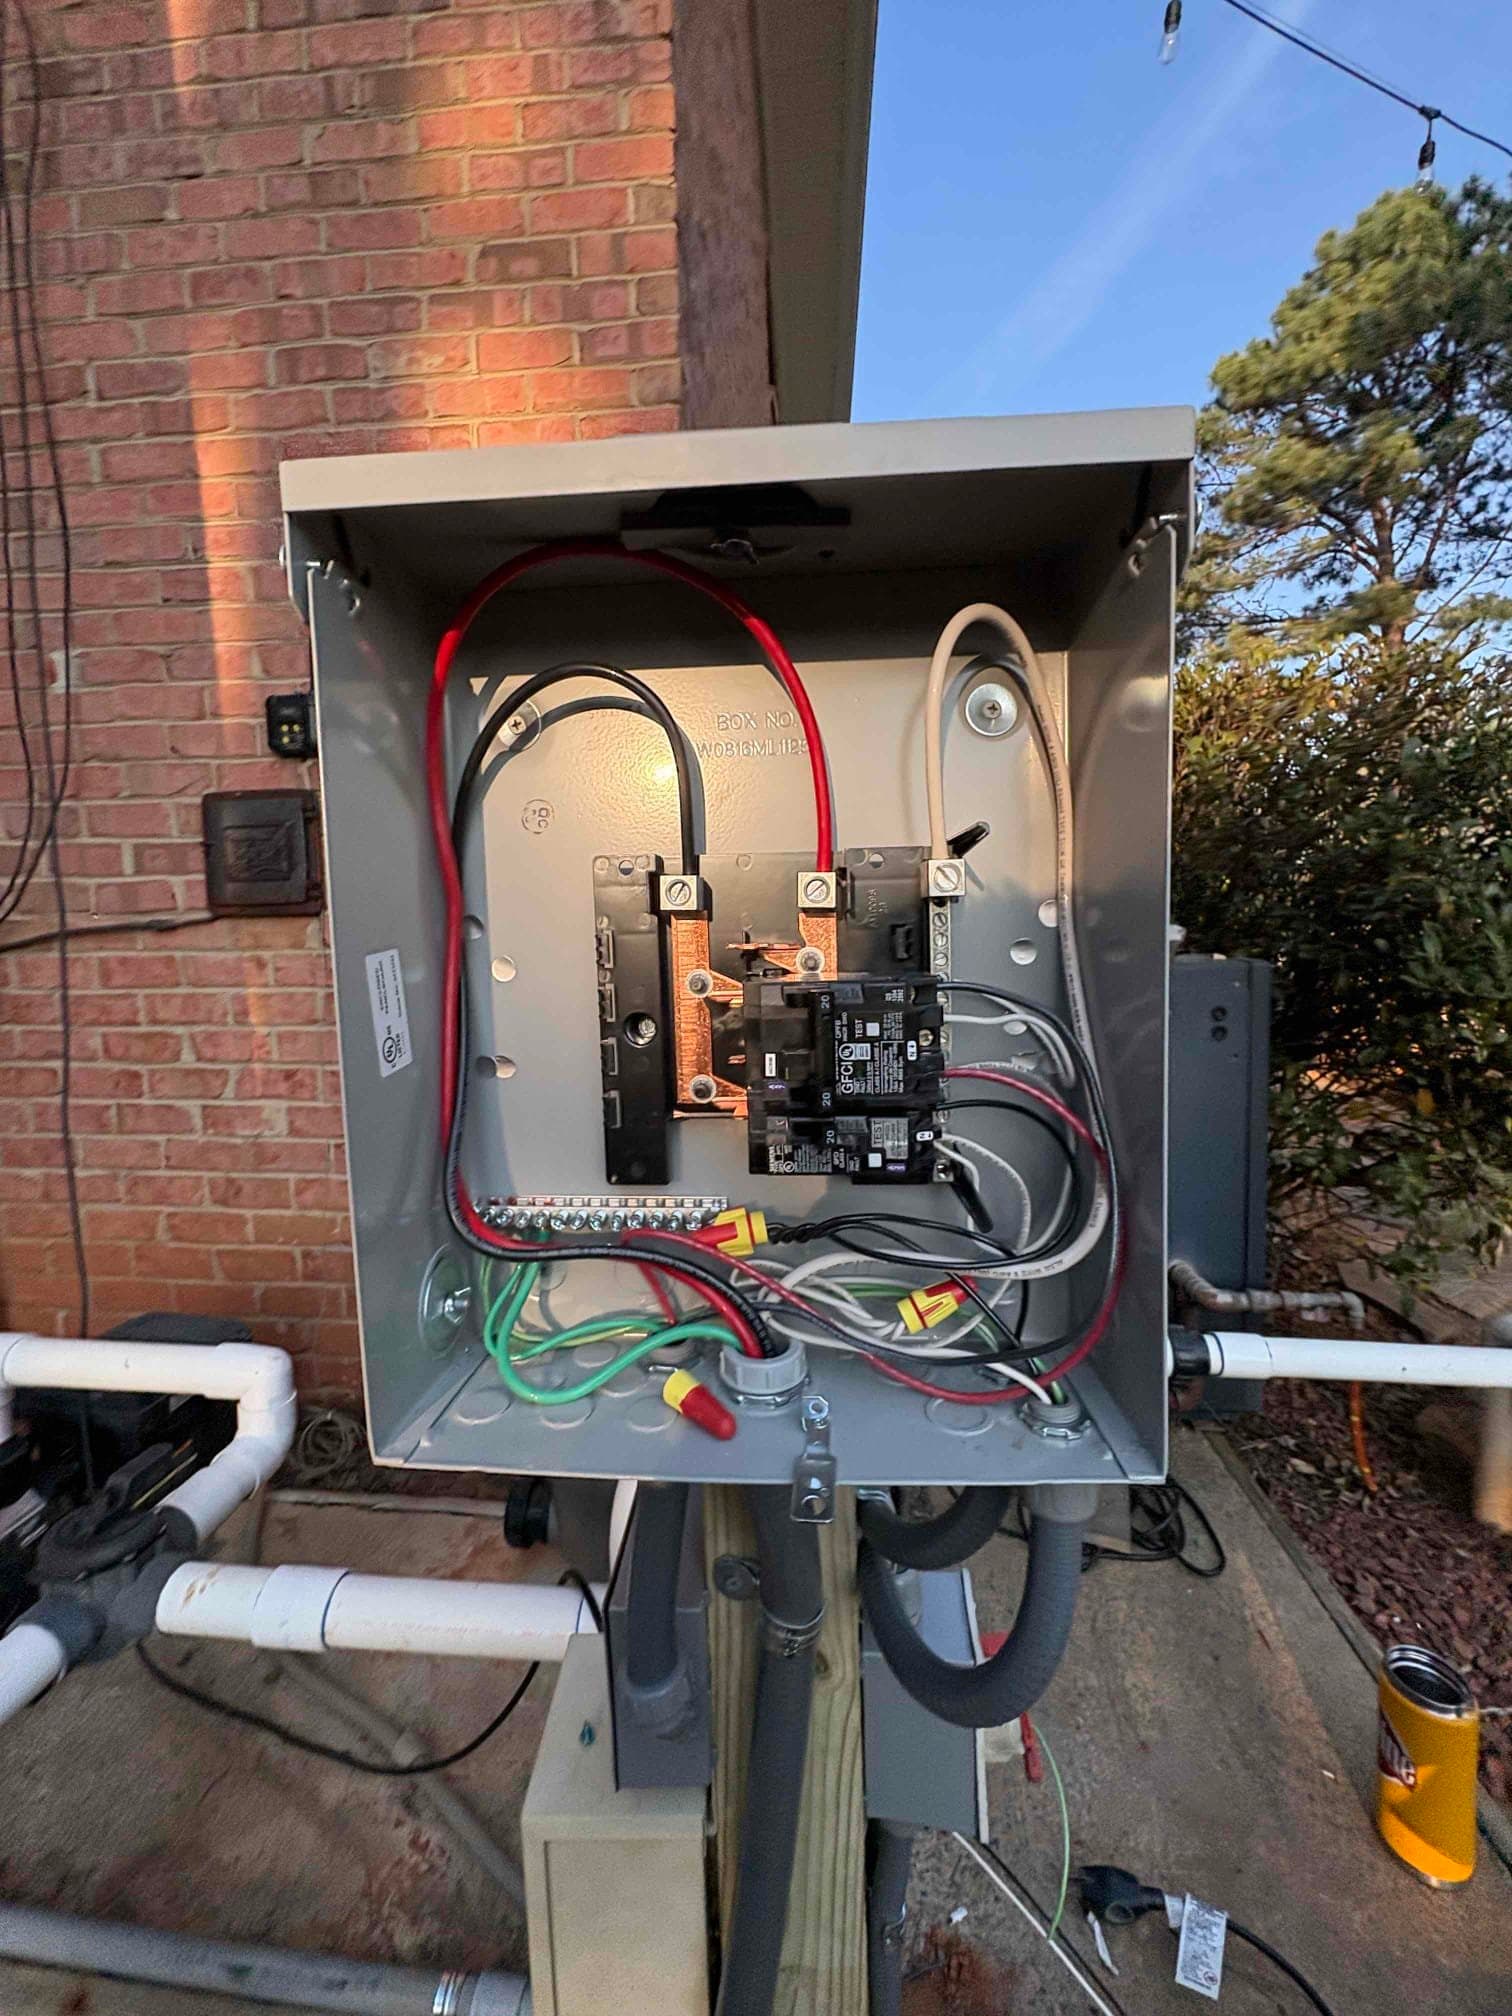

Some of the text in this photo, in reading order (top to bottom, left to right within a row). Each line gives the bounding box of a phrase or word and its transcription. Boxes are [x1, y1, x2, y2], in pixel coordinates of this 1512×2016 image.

[717, 711, 758, 732] BOX
[820, 994, 831, 1009] 20
[854, 1018, 864, 1039] TEST
[840, 1061, 854, 1094] GFCI
[822, 1092, 831, 1108] 20
[826, 1130, 835, 1145] 20
[873, 1119, 883, 1146] TEST
